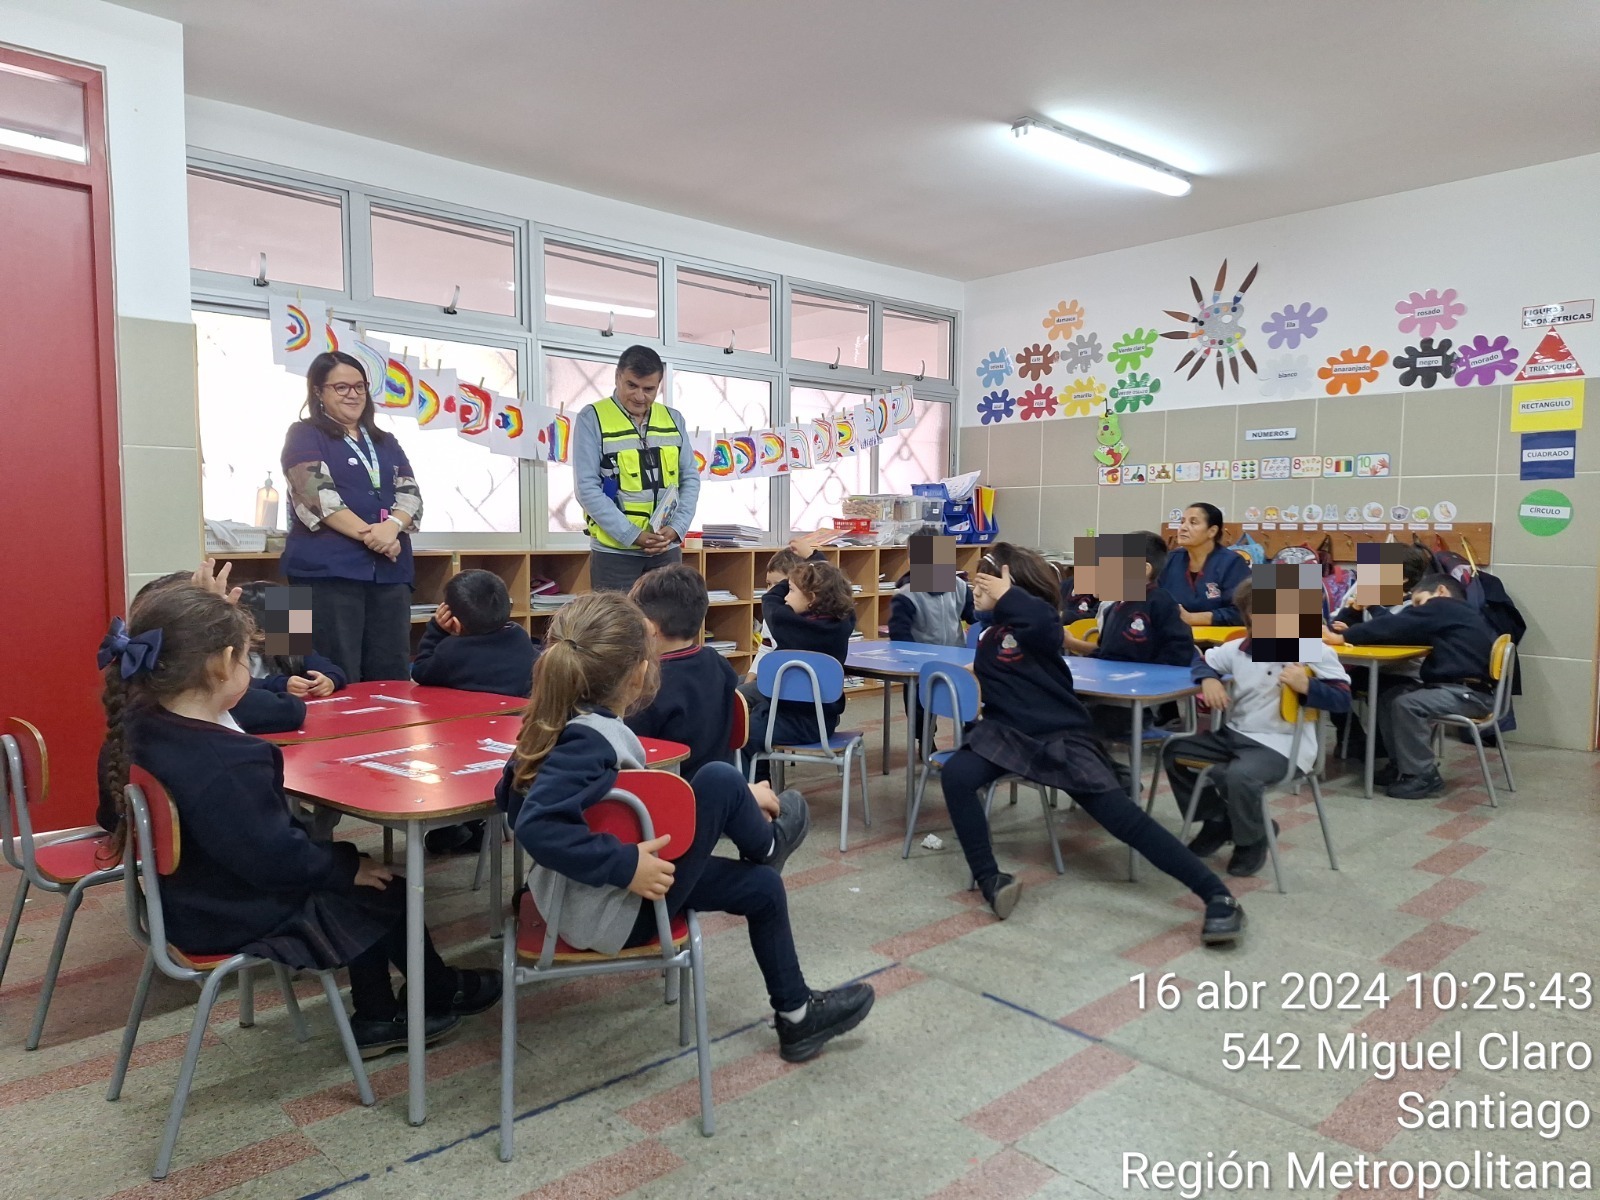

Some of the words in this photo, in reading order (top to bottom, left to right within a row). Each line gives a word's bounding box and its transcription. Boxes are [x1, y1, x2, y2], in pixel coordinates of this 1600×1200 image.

[1416, 308, 1441, 317] rosado
[1419, 357, 1439, 367] negro
[1471, 354, 1499, 366] morado
[1334, 363, 1370, 373] anaranjado
[1521, 400, 1571, 410] RECTANGULO
[1527, 450, 1569, 458] CUADRADO
[1263, 460, 1270, 471] 7
[1293, 459, 1301, 470] 8
[1325, 458, 1333, 469] 9
[1358, 456, 1371, 468] 10
[1124, 468, 1129, 476] 2
[1149, 466, 1156, 475] 3
[1176, 465, 1182, 473] 4
[1204, 463, 1211, 472] 5
[1232, 463, 1239, 472] 6
[1100, 469, 1105, 477] 1
